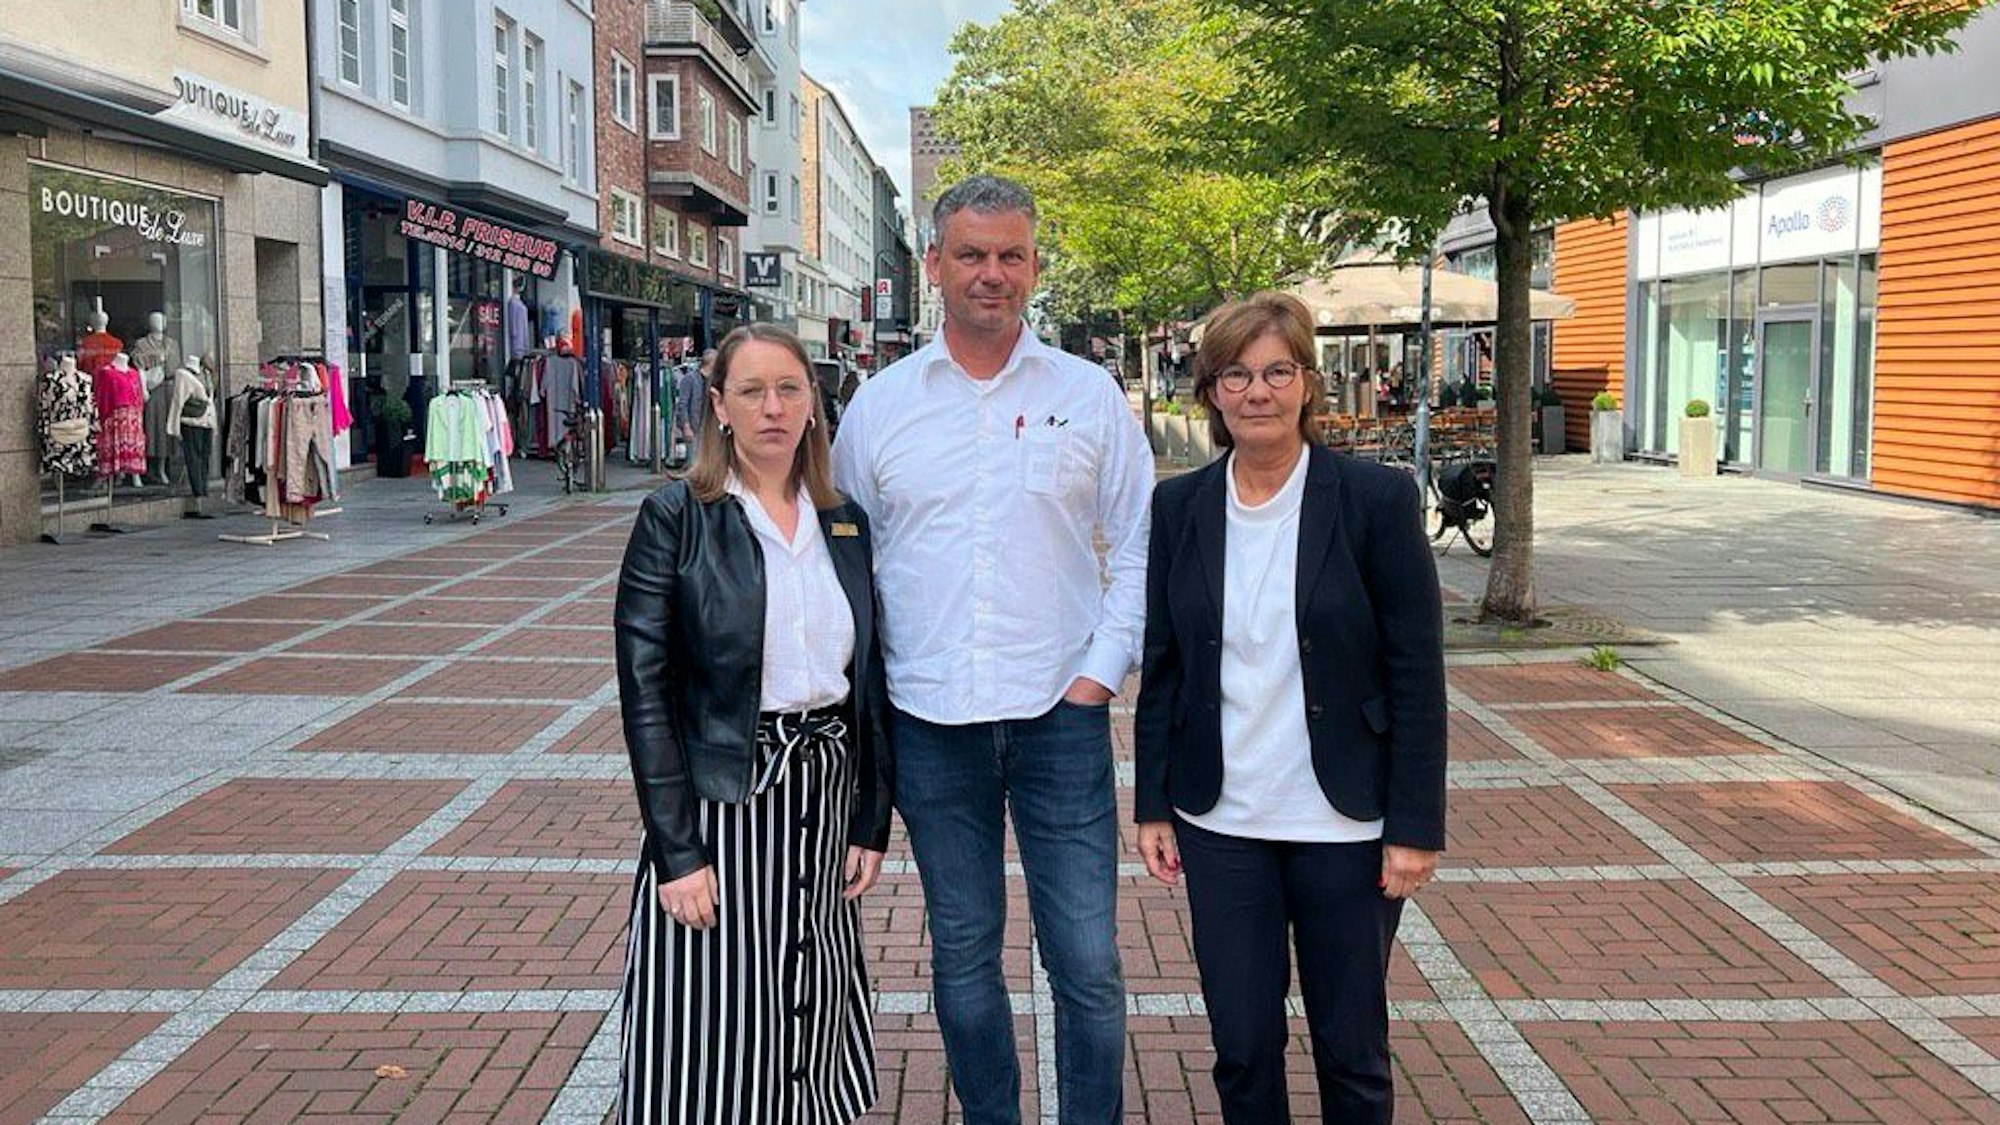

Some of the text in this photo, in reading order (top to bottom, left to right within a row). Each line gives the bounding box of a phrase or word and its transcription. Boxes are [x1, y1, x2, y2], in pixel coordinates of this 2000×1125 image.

[41, 186, 149, 228] BOUTIQUE
[1768, 210, 1811, 239] Apollo
[407, 200, 558, 264] V.I.P. FRISEUR
[478, 305, 500, 325] SALE
